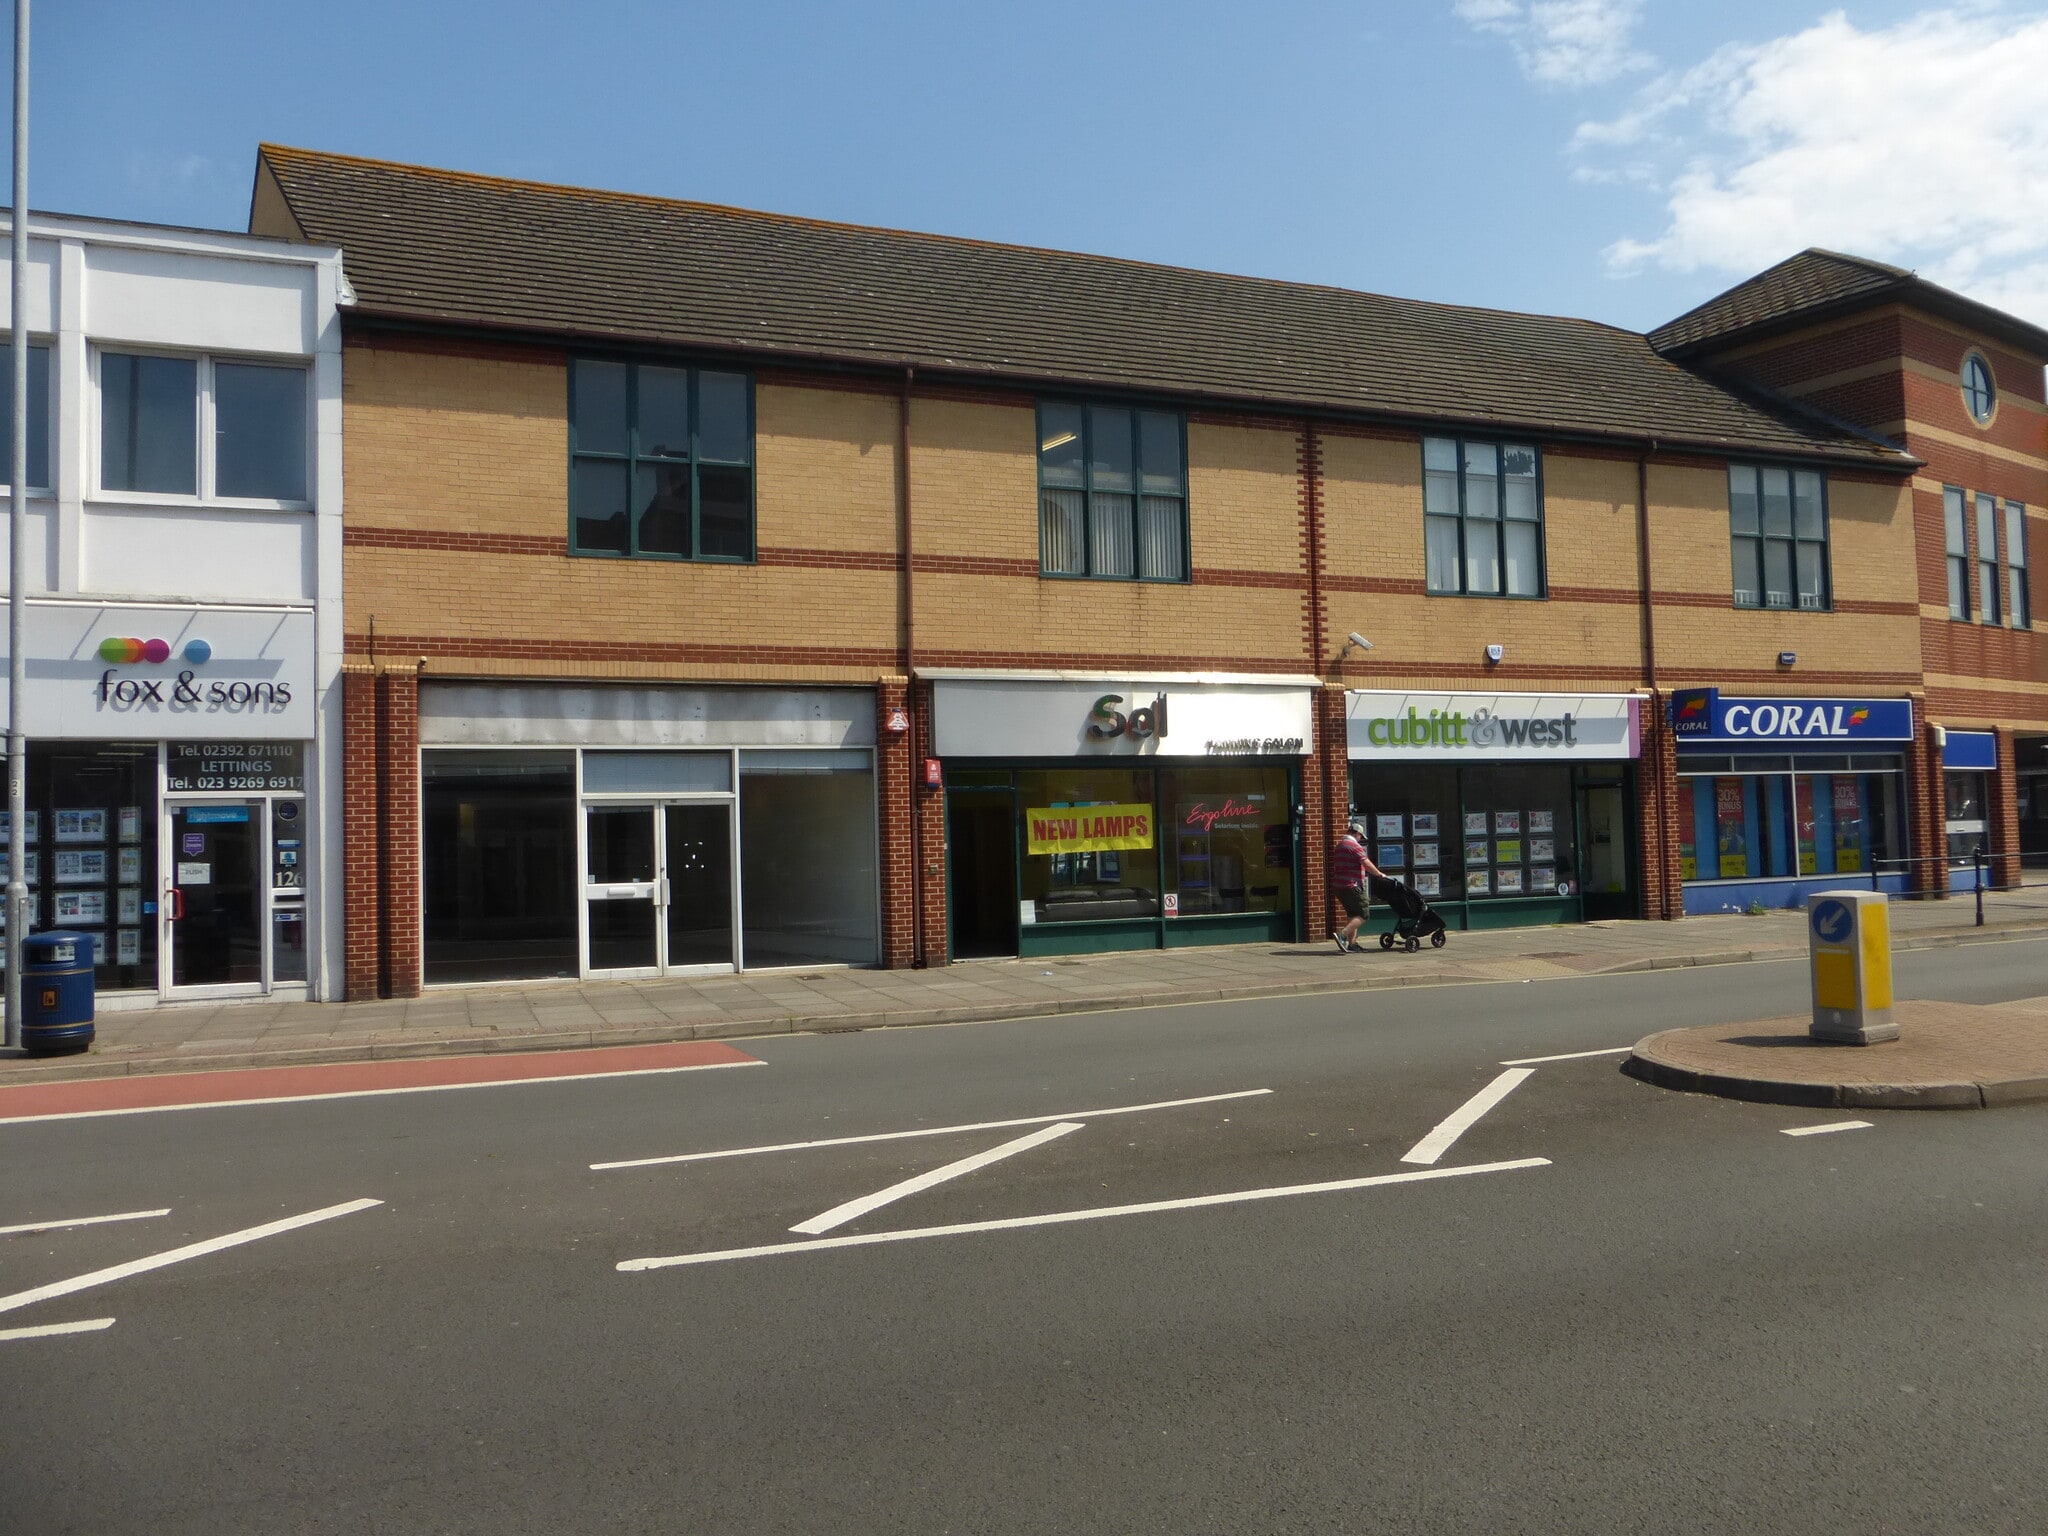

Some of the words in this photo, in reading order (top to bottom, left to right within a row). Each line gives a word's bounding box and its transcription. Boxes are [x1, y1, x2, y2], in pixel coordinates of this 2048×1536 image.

[98, 669, 164, 702] fox
[174, 670, 203, 703] &
[211, 681, 292, 704] sons
[1086, 691, 1168, 739] Sol
[1724, 705, 1849, 735] CORAL
[1675, 721, 1708, 731] CORAL
[178, 744, 200, 757] Tel.
[203, 744, 244, 756] 02392
[248, 744, 293, 757] 671110
[201, 760, 272, 773] LETTINGS
[167, 776, 193, 789] Tel.
[197, 776, 225, 789] 023
[229, 776, 265, 789] 9269
[269, 776, 304, 788] 6917
[1718, 788, 1740, 801] 30%
[1718, 801, 1742, 811] BONUS
[1033, 818, 1078, 841] NEW
[1083, 815, 1149, 838] LAMPS
[275, 871, 304, 887] 126
